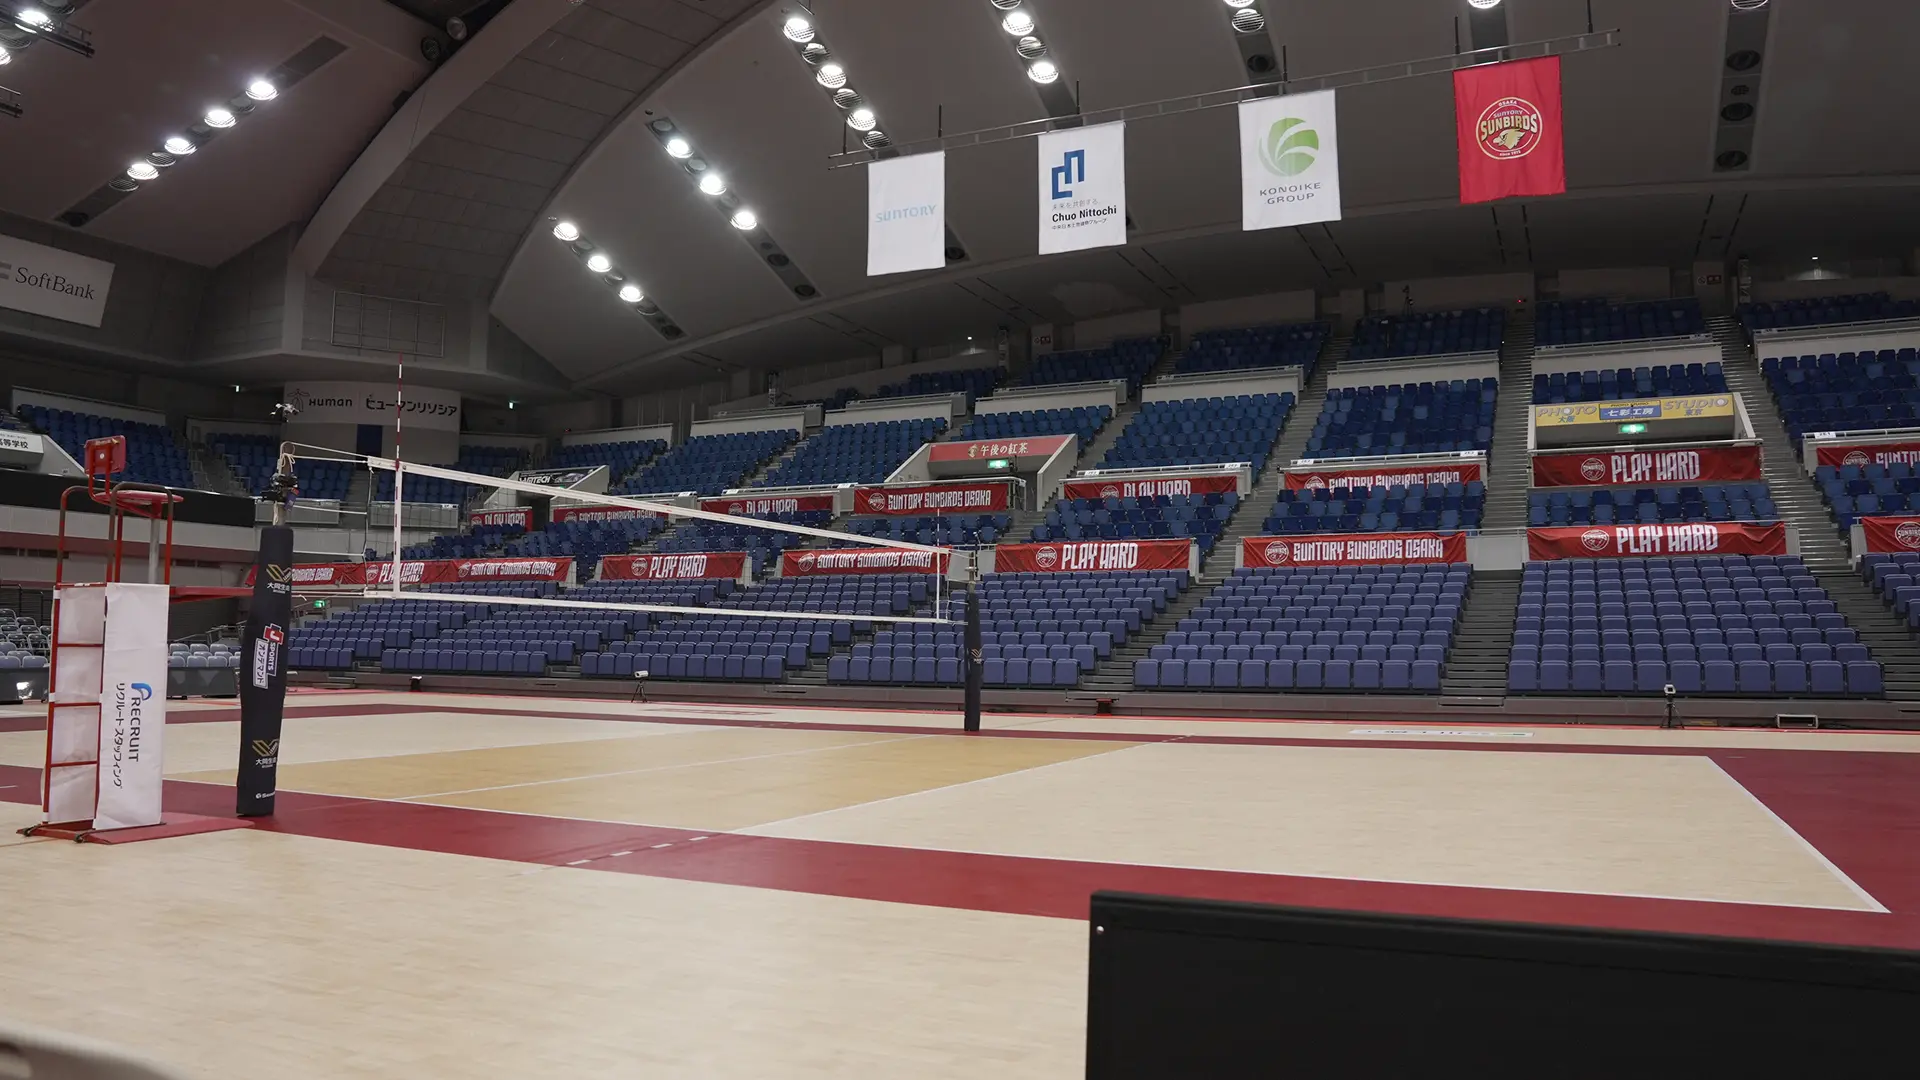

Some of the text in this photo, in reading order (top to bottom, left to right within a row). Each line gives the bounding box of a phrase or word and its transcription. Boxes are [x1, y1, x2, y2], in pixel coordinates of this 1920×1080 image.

[1480, 113, 1539, 142] SUNBIRDS
[1259, 182, 1322, 196] KONOIKE
[1267, 192, 1315, 204] GROUP
[875, 204, 937, 223] SUNTORY
[1052, 205, 1117, 223] Chuo Nittochi
[15, 266, 96, 301] SoftBank
[1537, 405, 1597, 417] PHOTO
[1663, 397, 1730, 411] STUDIO
[980, 443, 1028, 457] 午後の紅茶
[1611, 451, 1700, 482] PLAY HARD
[887, 489, 992, 510] SUNTORY SUNBIRDS OSAKA
[1293, 538, 1444, 561] SUNTORY SUNBIRDS OSAKA
[1616, 524, 1719, 554] PLAY HARD
[649, 555, 707, 578] PLAY HARD
[817, 553, 858, 569] SUNTORY
[857, 552, 900, 568] SUNBIRDS
[900, 551, 932, 568] OSAKA
[1061, 541, 1138, 570] PLAY HARD
[266, 630, 280, 671] J SPORTS
[256, 643, 266, 683] オンデマンド
[112, 682, 126, 789] リクルート スタッフィング
[128, 697, 141, 763] RECRUIT
